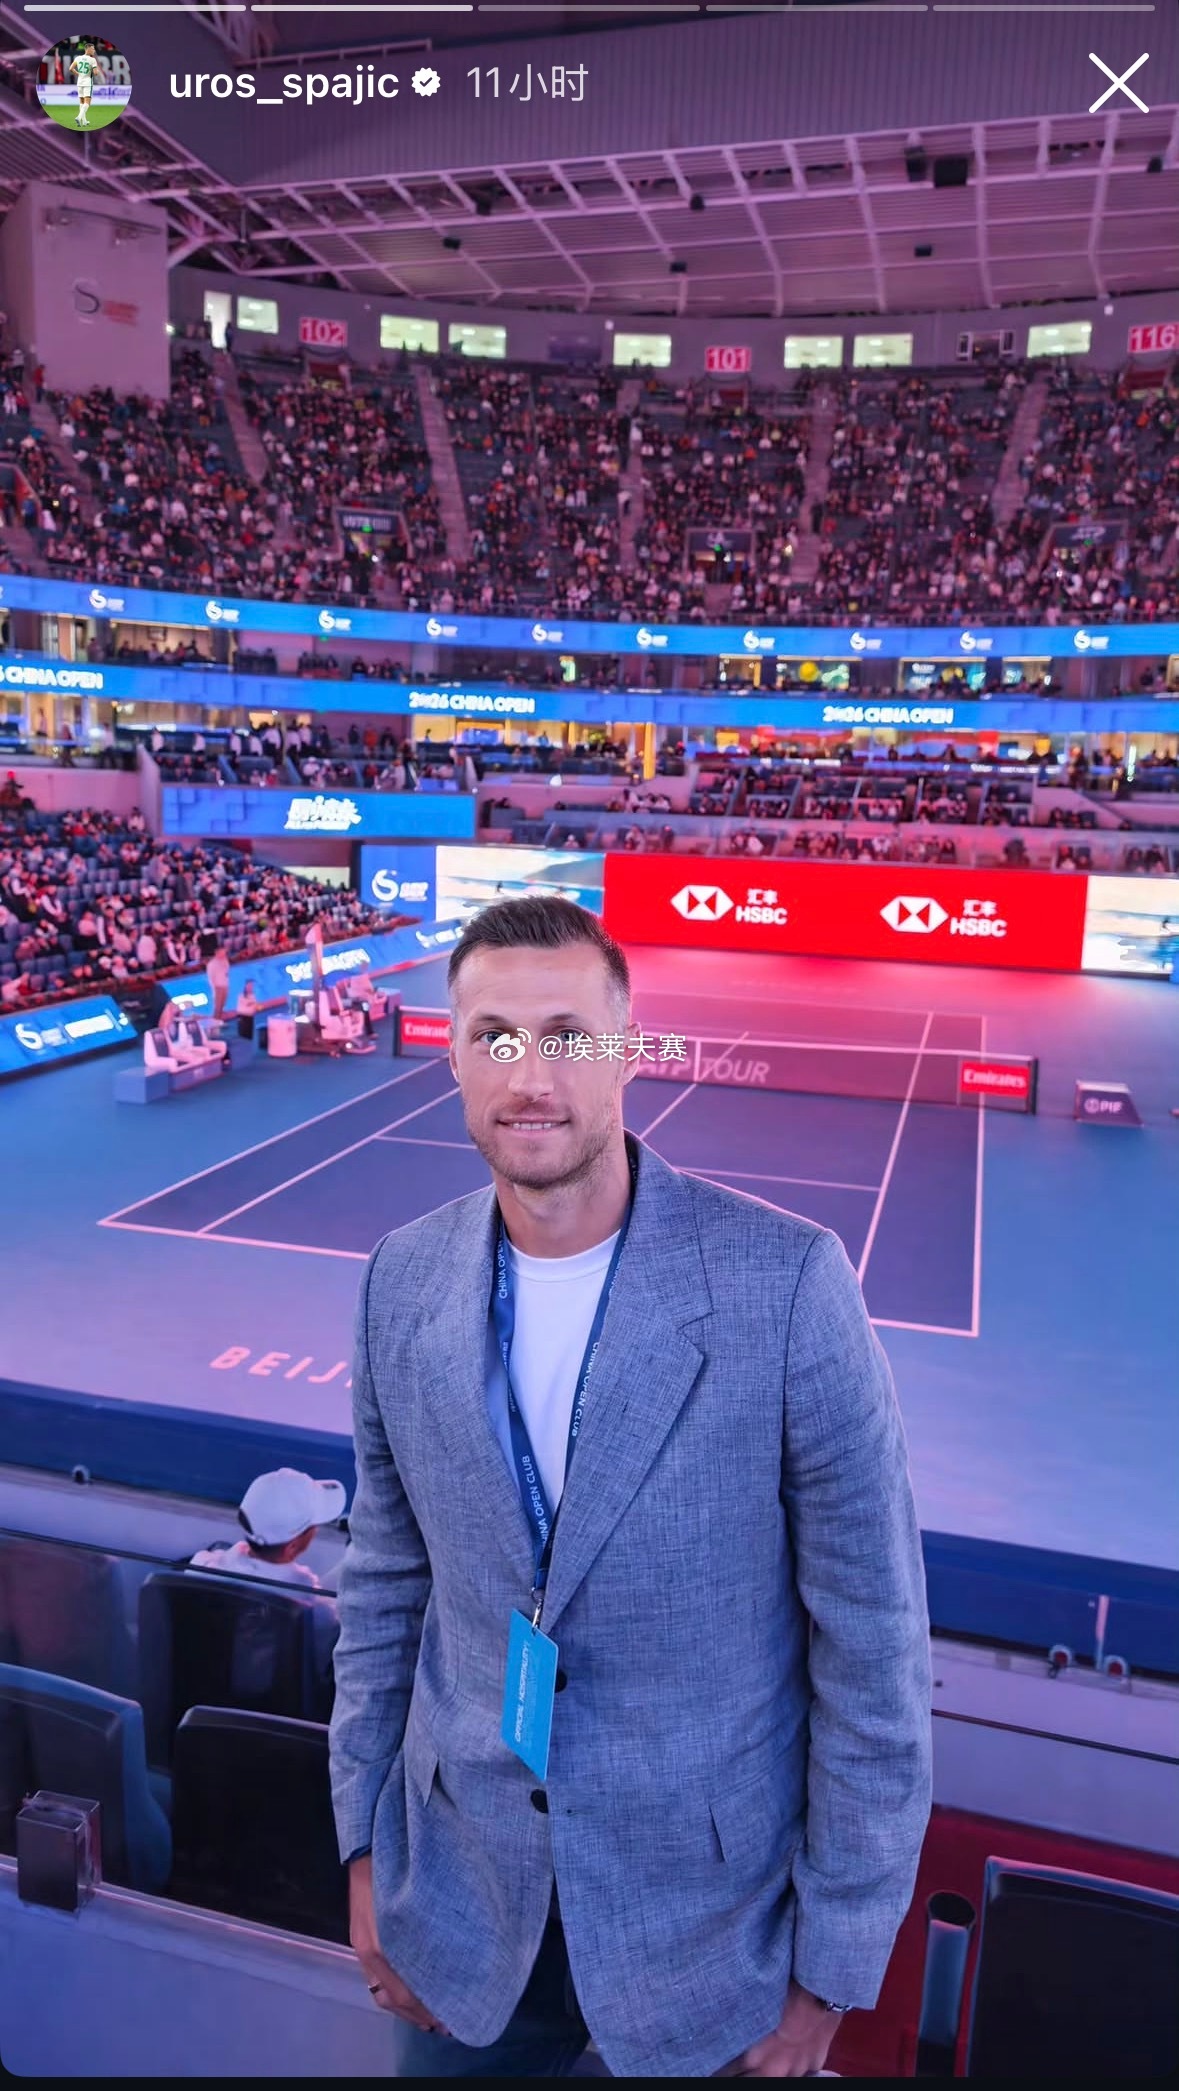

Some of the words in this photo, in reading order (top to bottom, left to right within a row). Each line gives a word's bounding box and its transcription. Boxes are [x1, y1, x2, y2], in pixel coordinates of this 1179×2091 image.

[301, 319, 345, 344] 102
[1130, 325, 1178, 352] 116
[708, 348, 750, 370] 101
[5, 665, 57, 686] CHINA
[56, 670, 104, 689] OPEN
[449, 694, 494, 712] CHINA
[494, 696, 535, 714] OPEN
[865, 707, 909, 724] CHINA
[909, 707, 953, 724] OPEN
[746, 887, 779, 906] 汇丰
[735, 906, 788, 925] HSBC
[962, 899, 997, 917] 汇丰
[950, 917, 1007, 938] HSBC
[700, 1057, 771, 1084] TOUR
[963, 1069, 1027, 1089] Emirates
[1100, 1099, 1124, 1113] PIF
[498, 1269, 508, 1300] CHINA
[571, 1408, 583, 1437] CLUB
[521, 1454, 536, 1484] CLUB
[529, 1486, 545, 1517] OPEN
